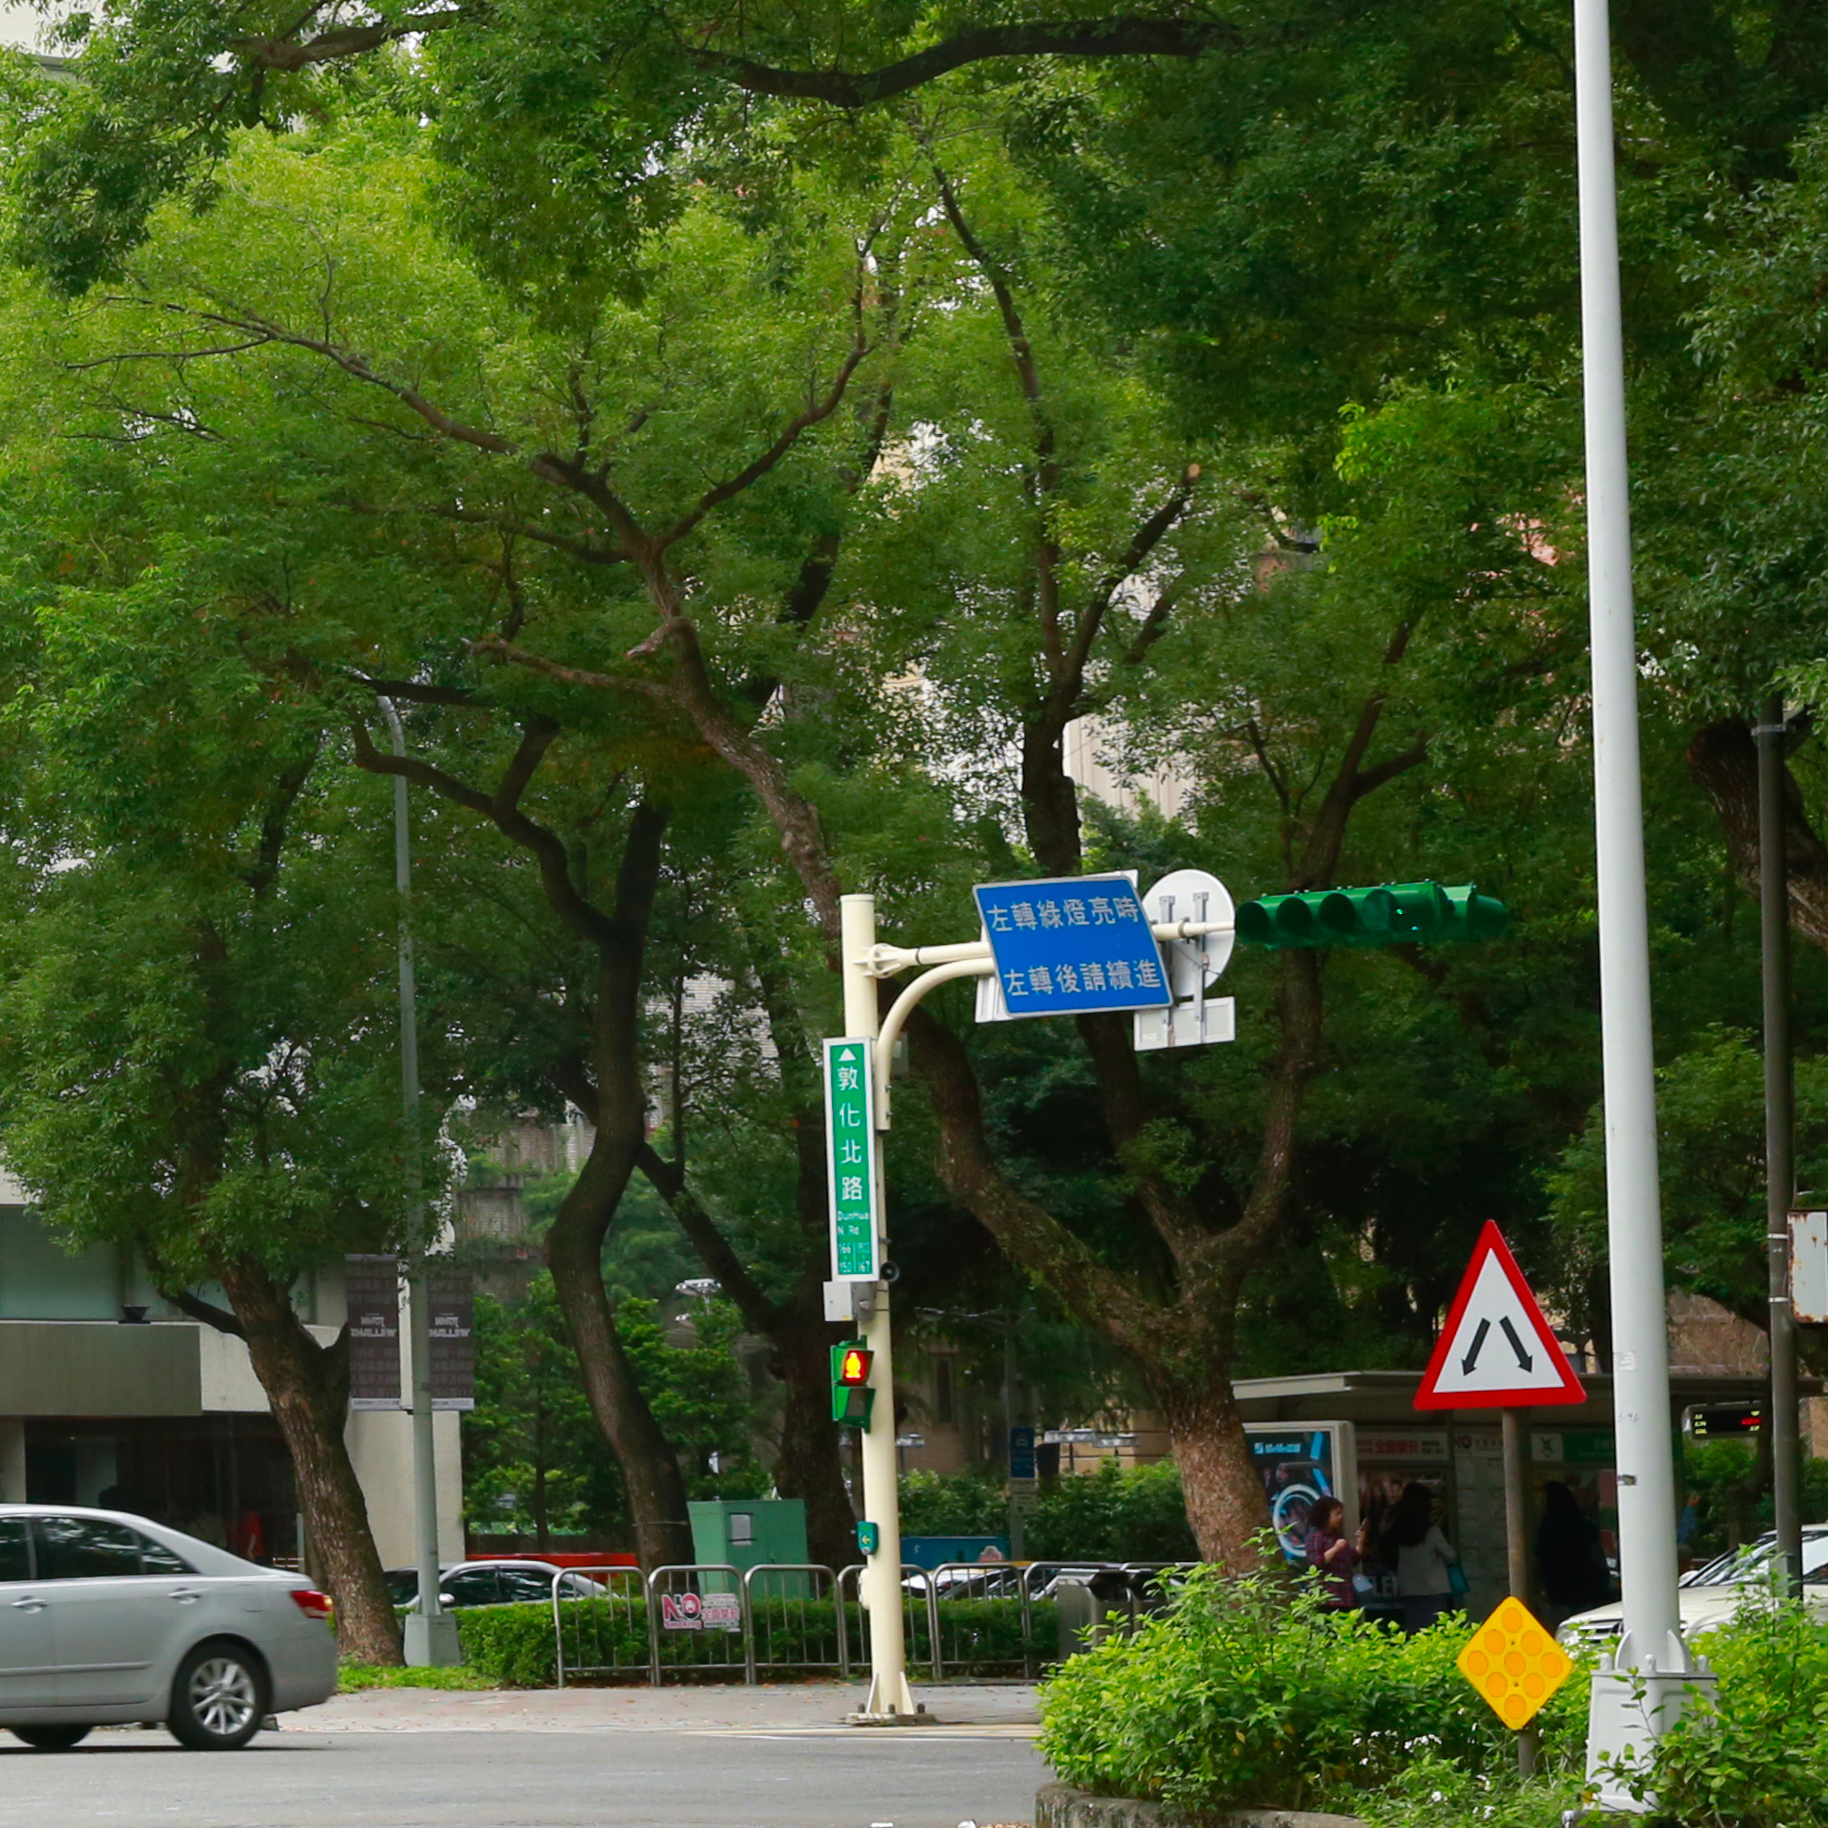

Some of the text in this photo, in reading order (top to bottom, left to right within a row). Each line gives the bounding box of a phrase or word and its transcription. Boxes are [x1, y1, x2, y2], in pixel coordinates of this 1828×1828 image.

[986, 896, 1140, 933] 左轉綠燈亮時
[1003, 959, 1162, 997] 左轉後請續進
[836, 1066, 863, 1201] 敦化北路
